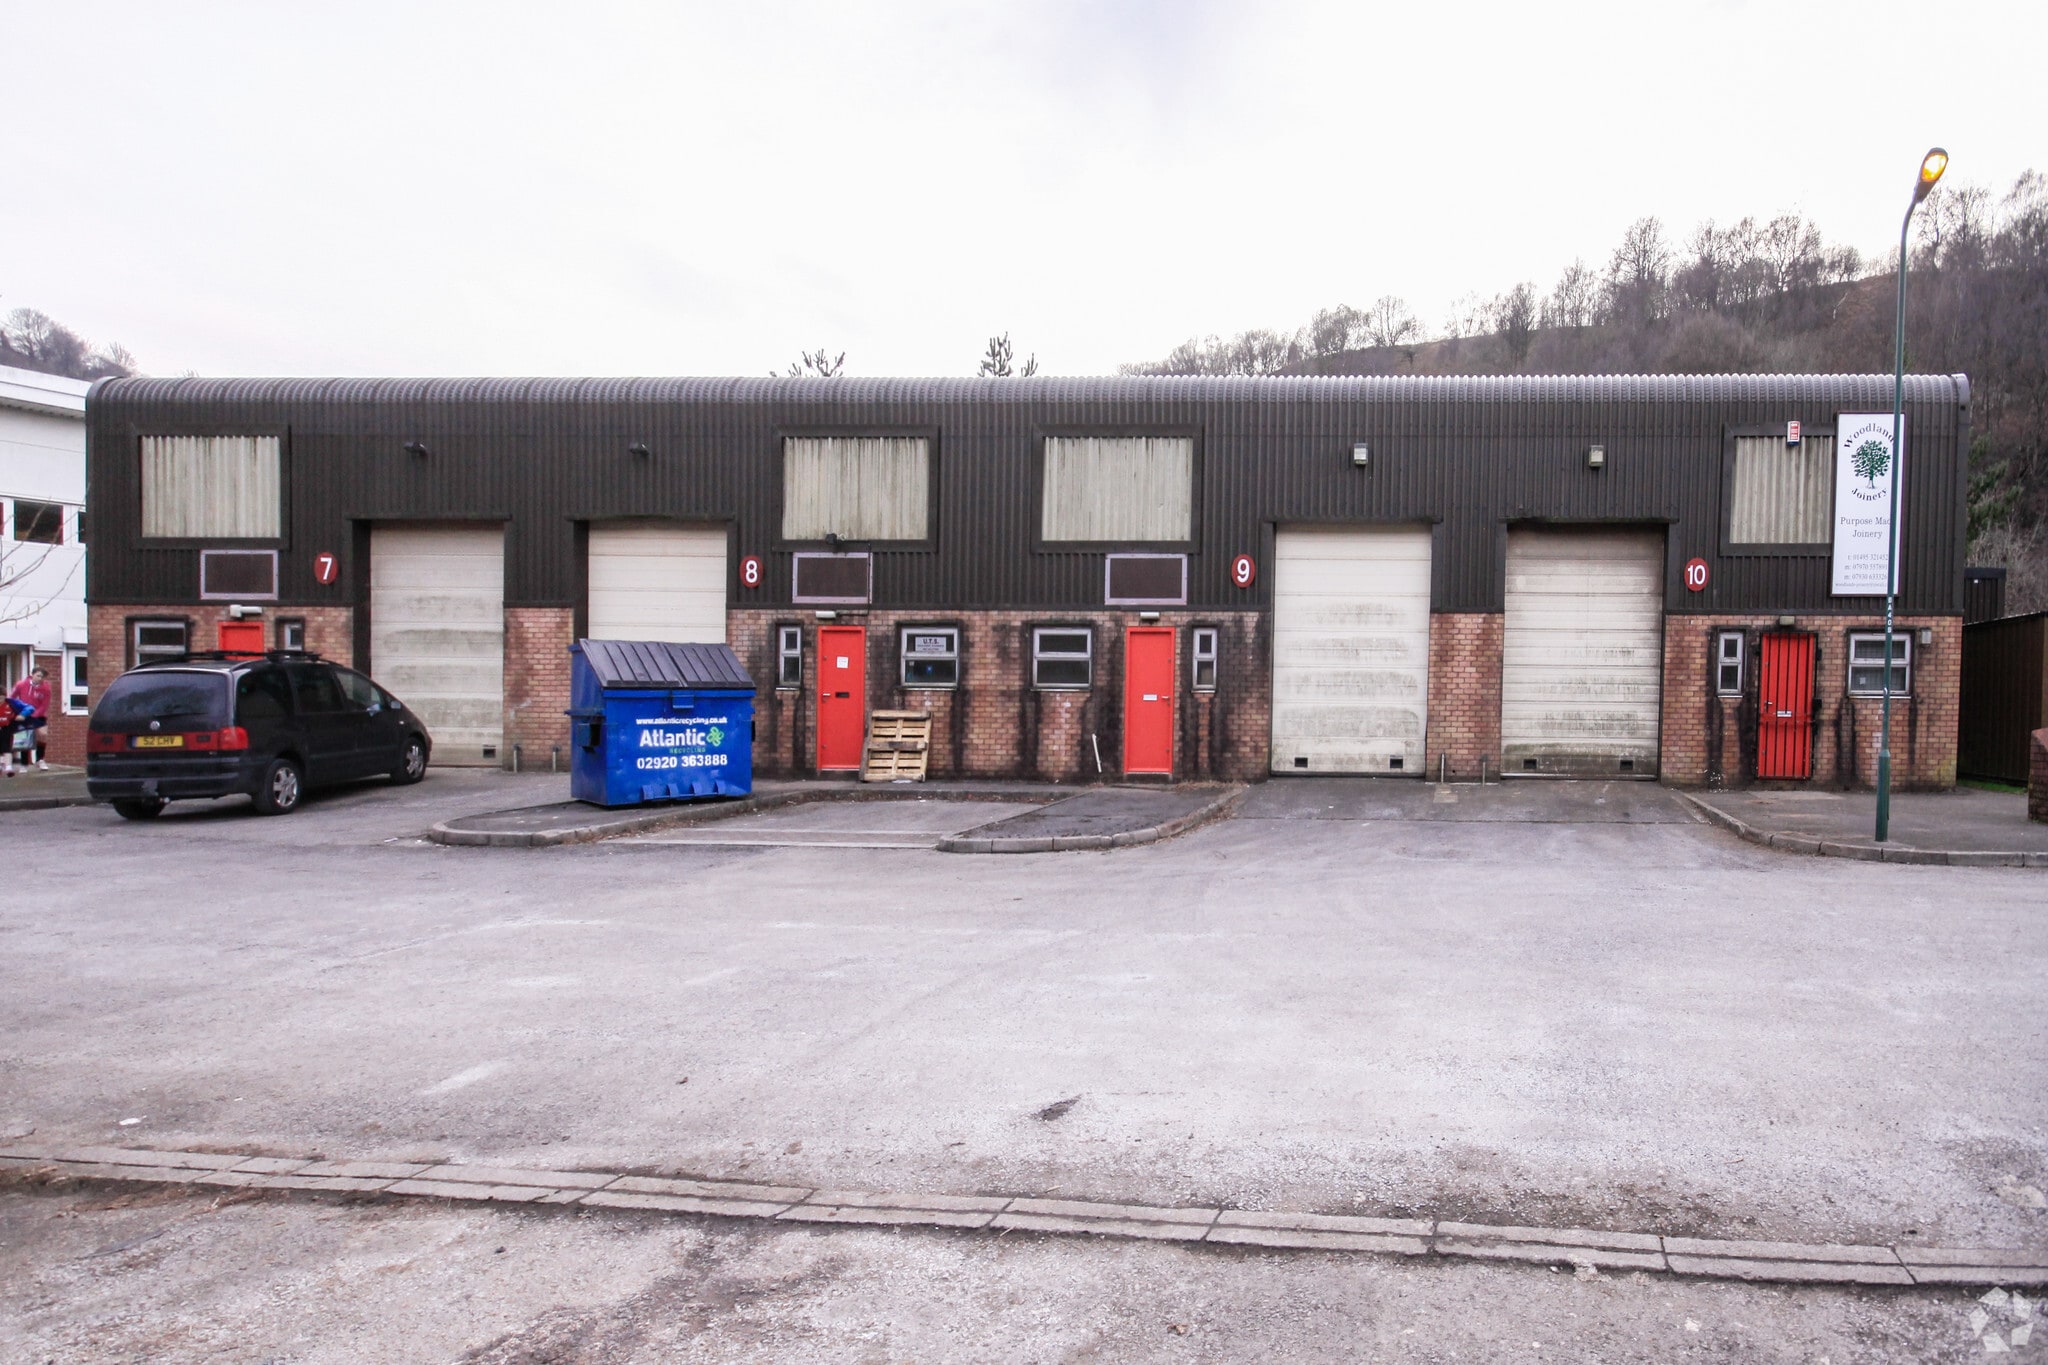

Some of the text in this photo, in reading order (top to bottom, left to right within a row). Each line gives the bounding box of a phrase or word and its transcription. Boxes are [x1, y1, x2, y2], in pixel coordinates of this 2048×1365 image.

[1851, 488, 1887, 501] Joinery
[1840, 517, 1872, 526] Purpose
[1852, 530, 1882, 539] Joinery
[320, 557, 332, 580] 7
[745, 559, 758, 583] 8
[1237, 559, 1250, 583] 9
[1687, 565, 1706, 585] 10
[636, 716, 728, 725] www.atlanticrecycling.co.uk
[640, 728, 706, 747] Atlantic
[637, 754, 728, 769] 02920 363888
